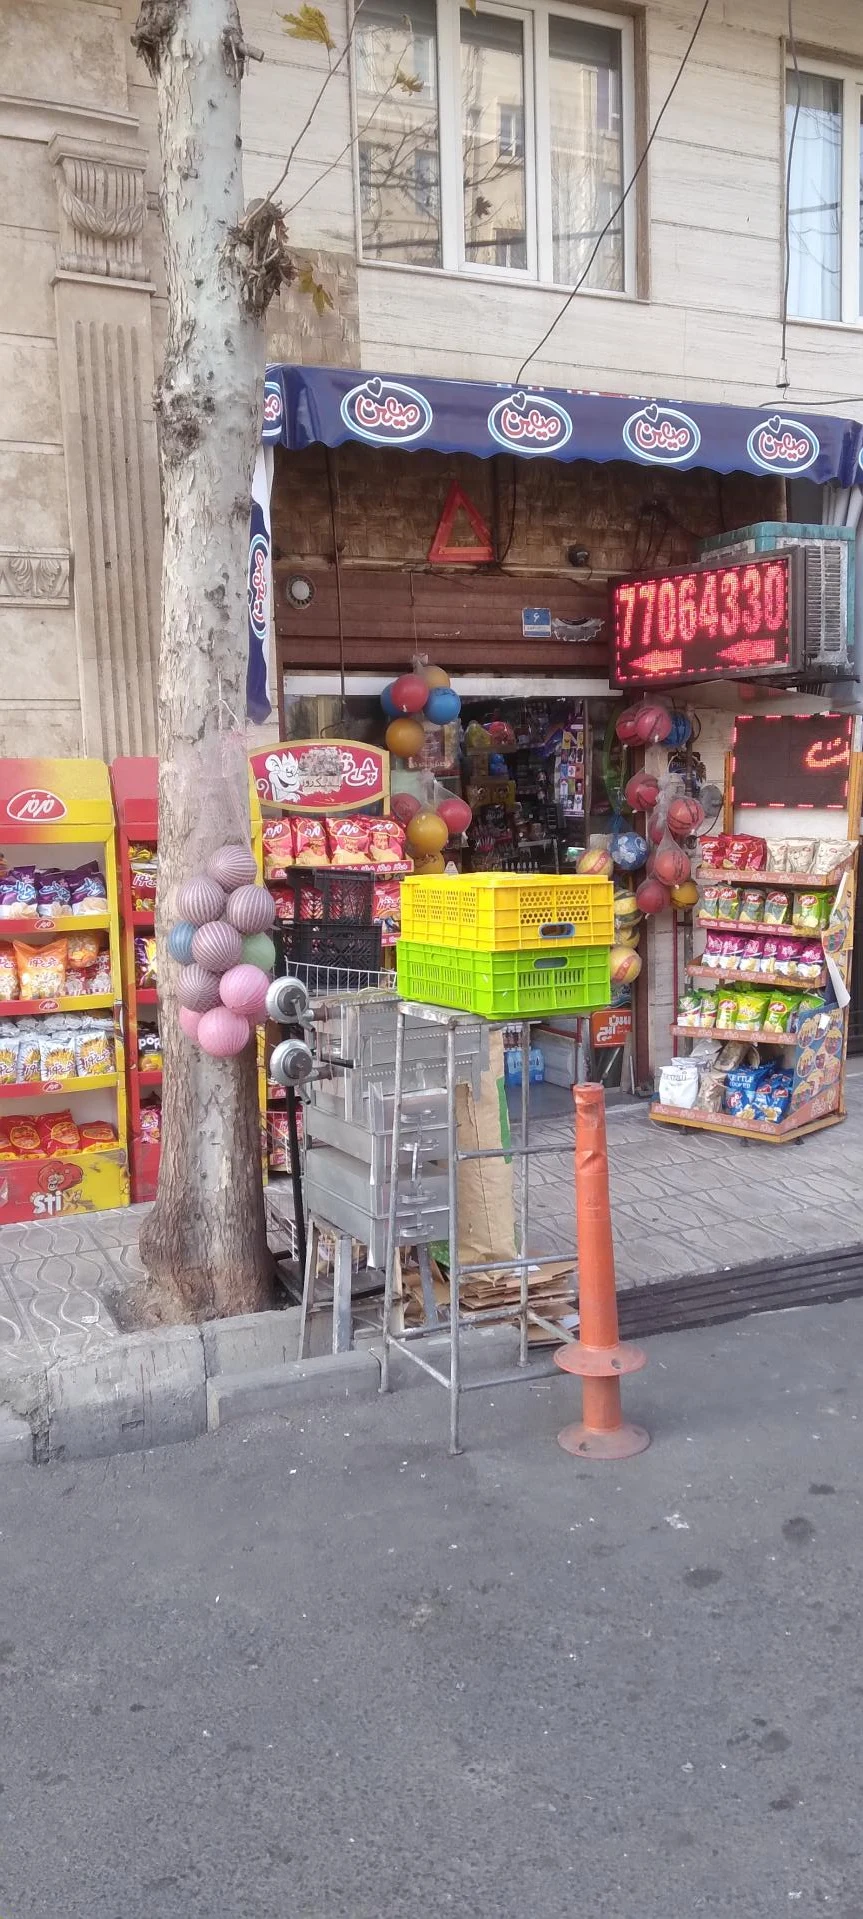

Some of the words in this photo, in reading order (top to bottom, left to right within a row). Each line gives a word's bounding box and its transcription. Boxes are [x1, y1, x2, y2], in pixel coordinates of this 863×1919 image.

[355, 395, 420, 430] میهن
[501, 407, 561, 440] میهن
[635, 419, 690, 450] میهن
[758, 431, 809, 462] میهن
[619, 565, 785, 649] 77064330
[17, 794, 55, 818] مزمز
